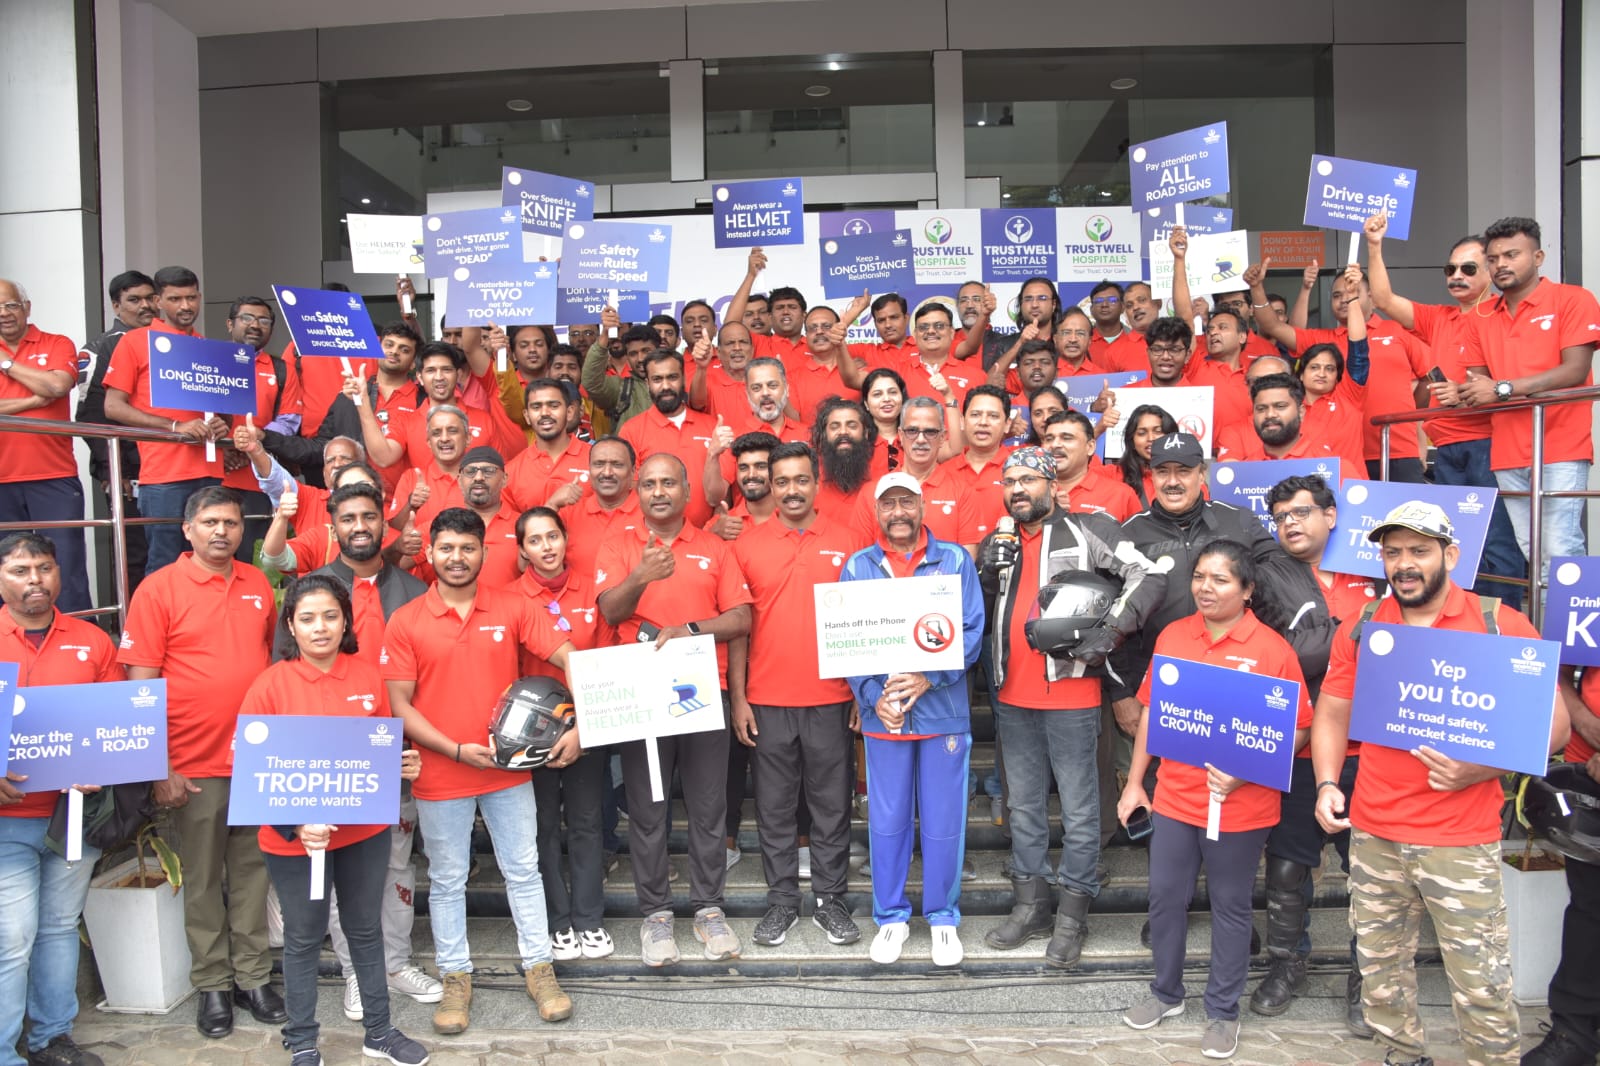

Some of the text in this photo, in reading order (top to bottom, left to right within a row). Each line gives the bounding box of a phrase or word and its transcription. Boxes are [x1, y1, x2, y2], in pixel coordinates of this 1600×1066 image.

[1145, 150, 1209, 172] Pay attention to
[1159, 164, 1195, 187] ALL
[1146, 178, 1212, 202] ROAD SIGNS
[520, 190, 539, 201] Over
[540, 194, 563, 205] Speed
[564, 198, 571, 207] is
[1322, 184, 1398, 209] Drive safe
[733, 202, 758, 212] Always
[759, 202, 776, 210] wear
[1321, 201, 1344, 211] Always
[1345, 205, 1362, 213] wear
[725, 210, 791, 229] HELMET
[1328, 211, 1365, 223] while riding
[536, 219, 548, 227] cut
[550, 220, 562, 229] the
[1188, 224, 1206, 232] wear
[726, 229, 751, 239] instead
[752, 229, 760, 237] of
[767, 227, 792, 236] SCARF
[436, 232, 510, 248] Don't "STATUS"
[1263, 237, 1293, 245] DONOT
[490, 243, 510, 251] gonna
[599, 244, 639, 258] Safety
[912, 246, 974, 256] RUSTWELL
[984, 244, 1055, 256] TRUSTWELL
[1064, 244, 1135, 254] TRUSTWELL
[1263, 246, 1280, 254] ANY
[1283, 246, 1294, 254] OF
[455, 253, 493, 265] "DEAD"
[603, 257, 638, 269] Rules
[856, 255, 873, 264] Keep
[992, 256, 1047, 265] HOSPITALS
[1072, 255, 1127, 264] HOSPITALS
[829, 259, 907, 276] LONG DISTANCE
[608, 270, 648, 282] Speed
[848, 270, 890, 281] Relationship
[476, 280, 515, 289] motorbike
[480, 288, 523, 300] TWO
[301, 312, 348, 326] LOVE Safety
[467, 307, 534, 319] TOO MANY
[326, 325, 354, 337] Rules
[311, 337, 368, 350] DIVORCE Speed
[191, 362, 212, 374] Keep
[159, 368, 249, 388] LONG DISTANCE
[181, 382, 230, 395] Relationship
[1068, 396, 1083, 405] Pay
[1233, 486, 1242, 495] A
[1356, 550, 1373, 561] no
[824, 617, 906, 629] Hands off the Phone
[826, 635, 907, 649] MOBILE PHONE
[1431, 658, 1467, 682] Yep
[580, 680, 615, 691] Use your
[583, 685, 636, 706] BRAIN
[1398, 681, 1496, 711] you too
[585, 708, 612, 716] Always
[613, 704, 632, 712] wear
[1159, 700, 1214, 724] Wear the
[586, 709, 654, 732] HELMET
[1398, 707, 1489, 733] It's road safety.
[96, 724, 156, 740] Rule the
[1159, 715, 1211, 738] CROWN
[1219, 724, 1227, 734] &
[1231, 717, 1284, 741] Rule the
[48, 730, 73, 743] the
[1386, 722, 1496, 750] not rocket science
[81, 738, 91, 747] &
[103, 738, 149, 753] ROAD
[1235, 733, 1277, 754] ROAD
[265, 756, 371, 769] There are some
[254, 773, 380, 793] TROPHIES
[269, 794, 362, 807] no one wants
